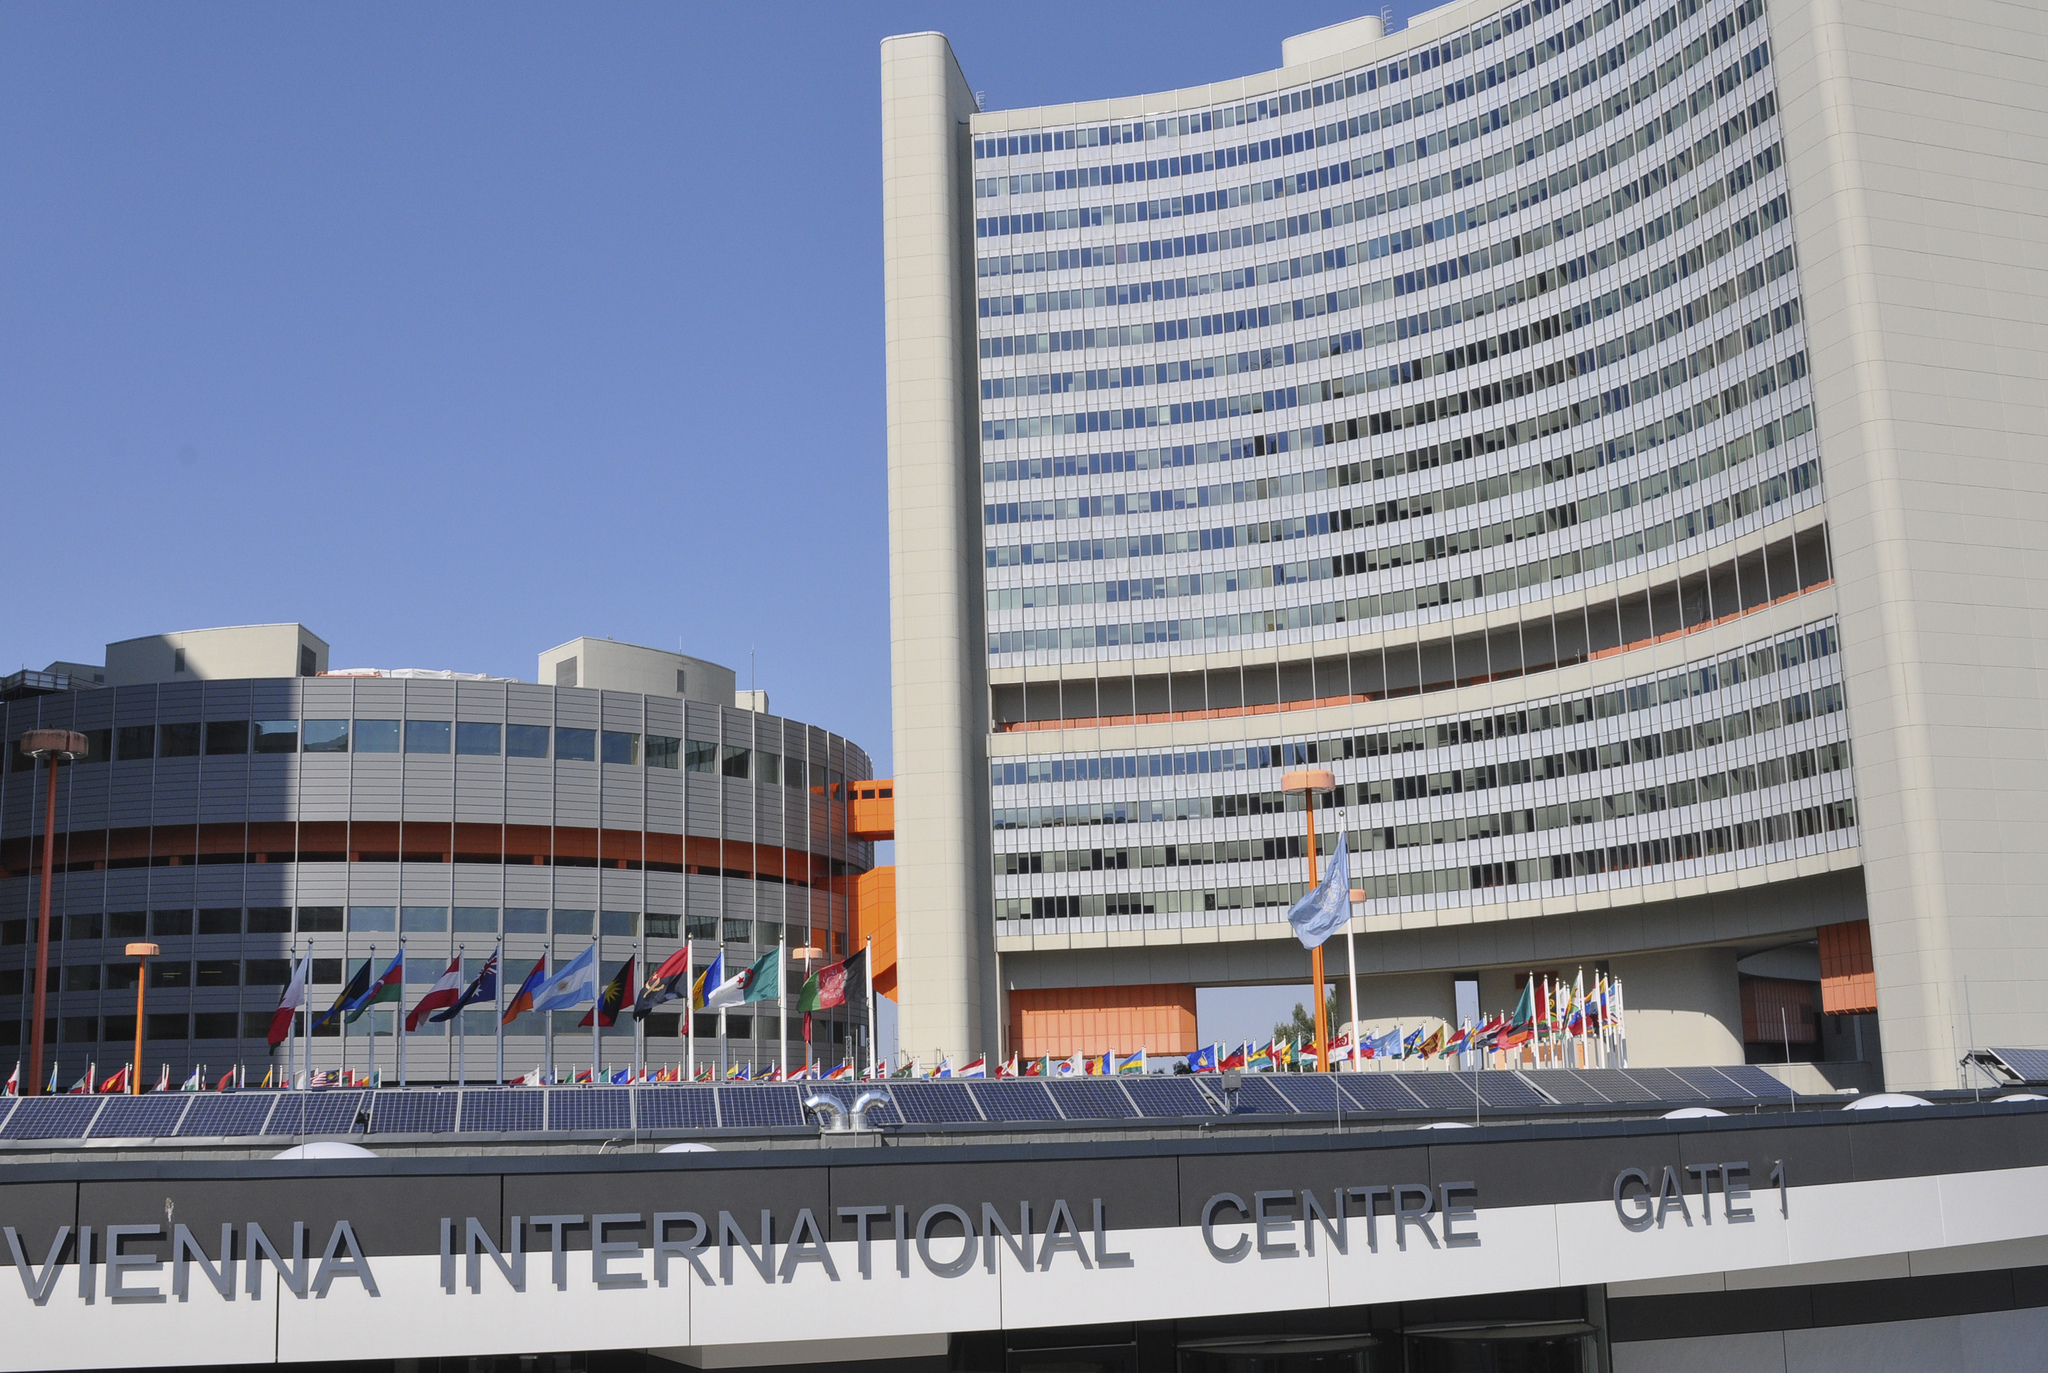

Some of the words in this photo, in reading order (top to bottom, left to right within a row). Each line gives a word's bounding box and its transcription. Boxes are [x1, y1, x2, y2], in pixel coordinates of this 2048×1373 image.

[3, 1220, 379, 1302] VIENNA
[440, 1197, 1132, 1291] INTERNATIONAL
[1201, 1181, 1479, 1260] CENTRE
[1614, 1161, 1753, 1227] GATE
[1770, 1158, 1789, 1221] 1
